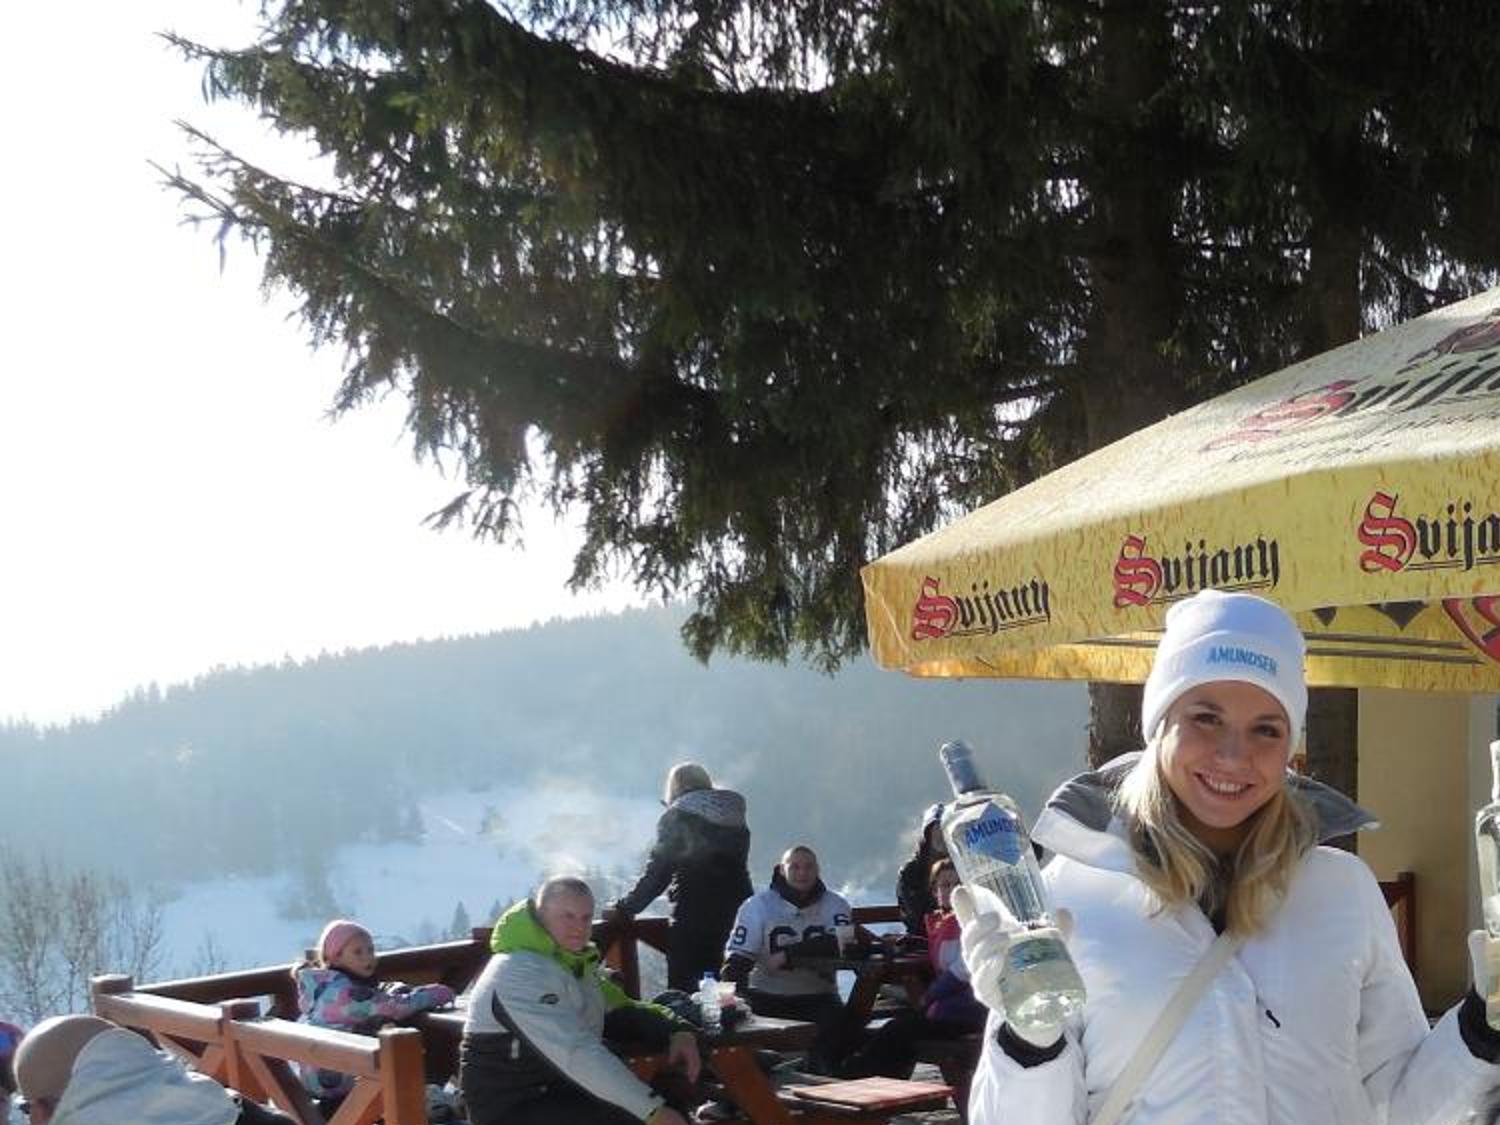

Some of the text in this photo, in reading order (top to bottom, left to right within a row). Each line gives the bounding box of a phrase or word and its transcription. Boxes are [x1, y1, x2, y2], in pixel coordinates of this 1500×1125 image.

[1113, 534, 1279, 608] Svijany
[912, 575, 1050, 641] Svijany
[1206, 645, 1278, 676] AMUNDSEN
